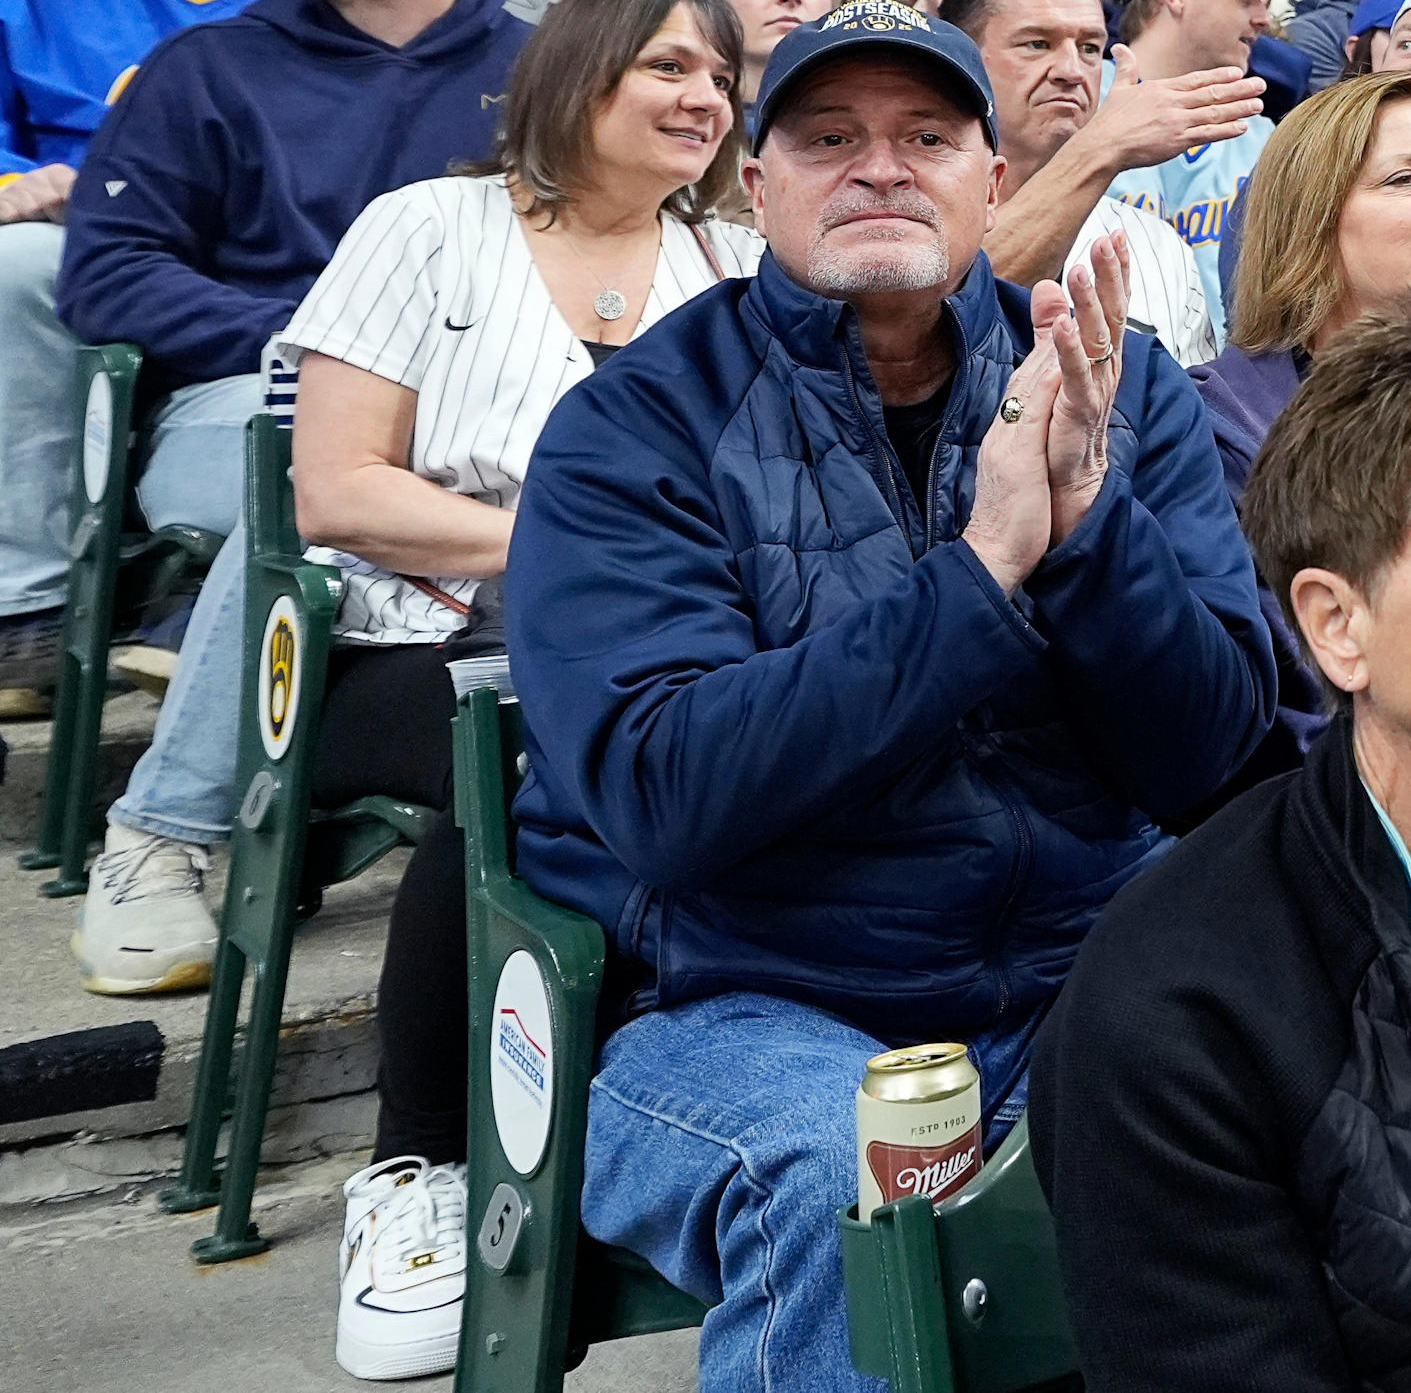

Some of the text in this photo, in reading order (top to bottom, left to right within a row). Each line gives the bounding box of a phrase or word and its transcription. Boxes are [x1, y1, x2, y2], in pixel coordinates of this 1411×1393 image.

[943, 1115, 966, 1130] 1903
[896, 1145, 976, 1198] Miller
[490, 1202, 511, 1247] 5
